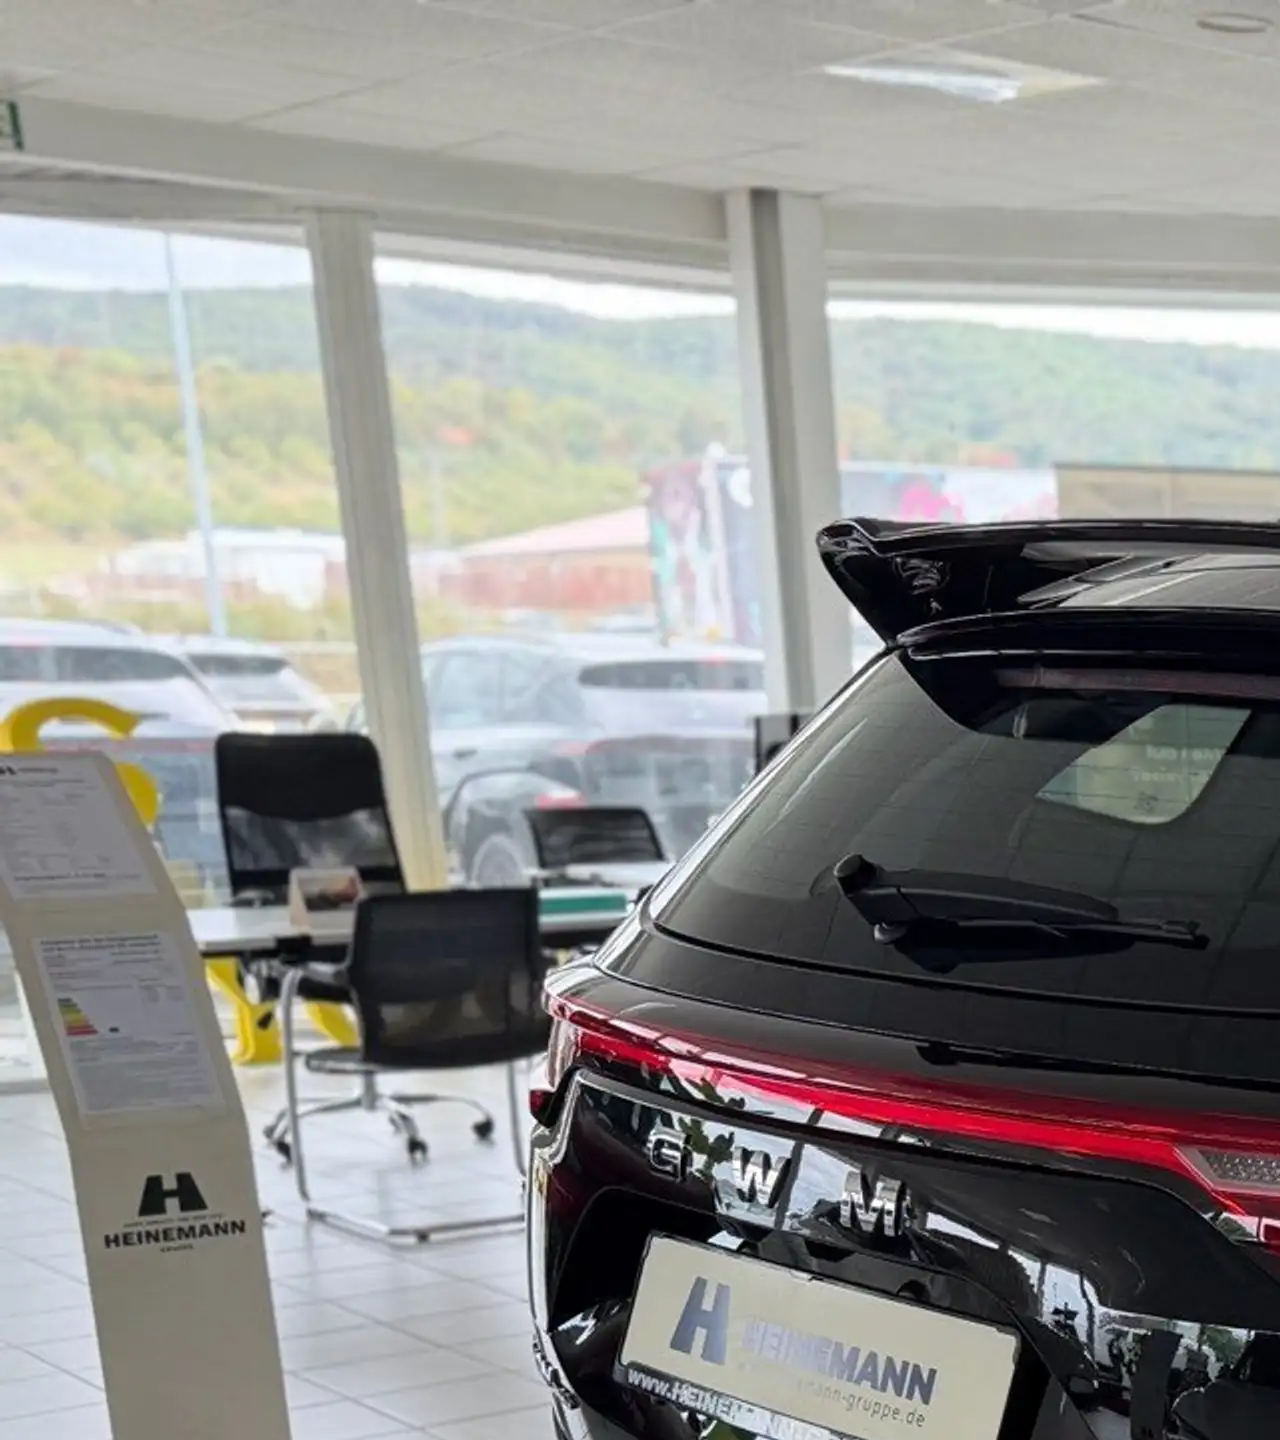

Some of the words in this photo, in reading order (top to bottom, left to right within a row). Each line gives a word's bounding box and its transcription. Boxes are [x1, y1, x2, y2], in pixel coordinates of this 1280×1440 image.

[646, 1126, 903, 1237] GWM
[103, 1219, 246, 1249] HEINEMANN
[742, 1316, 938, 1405] HEINEMANN
